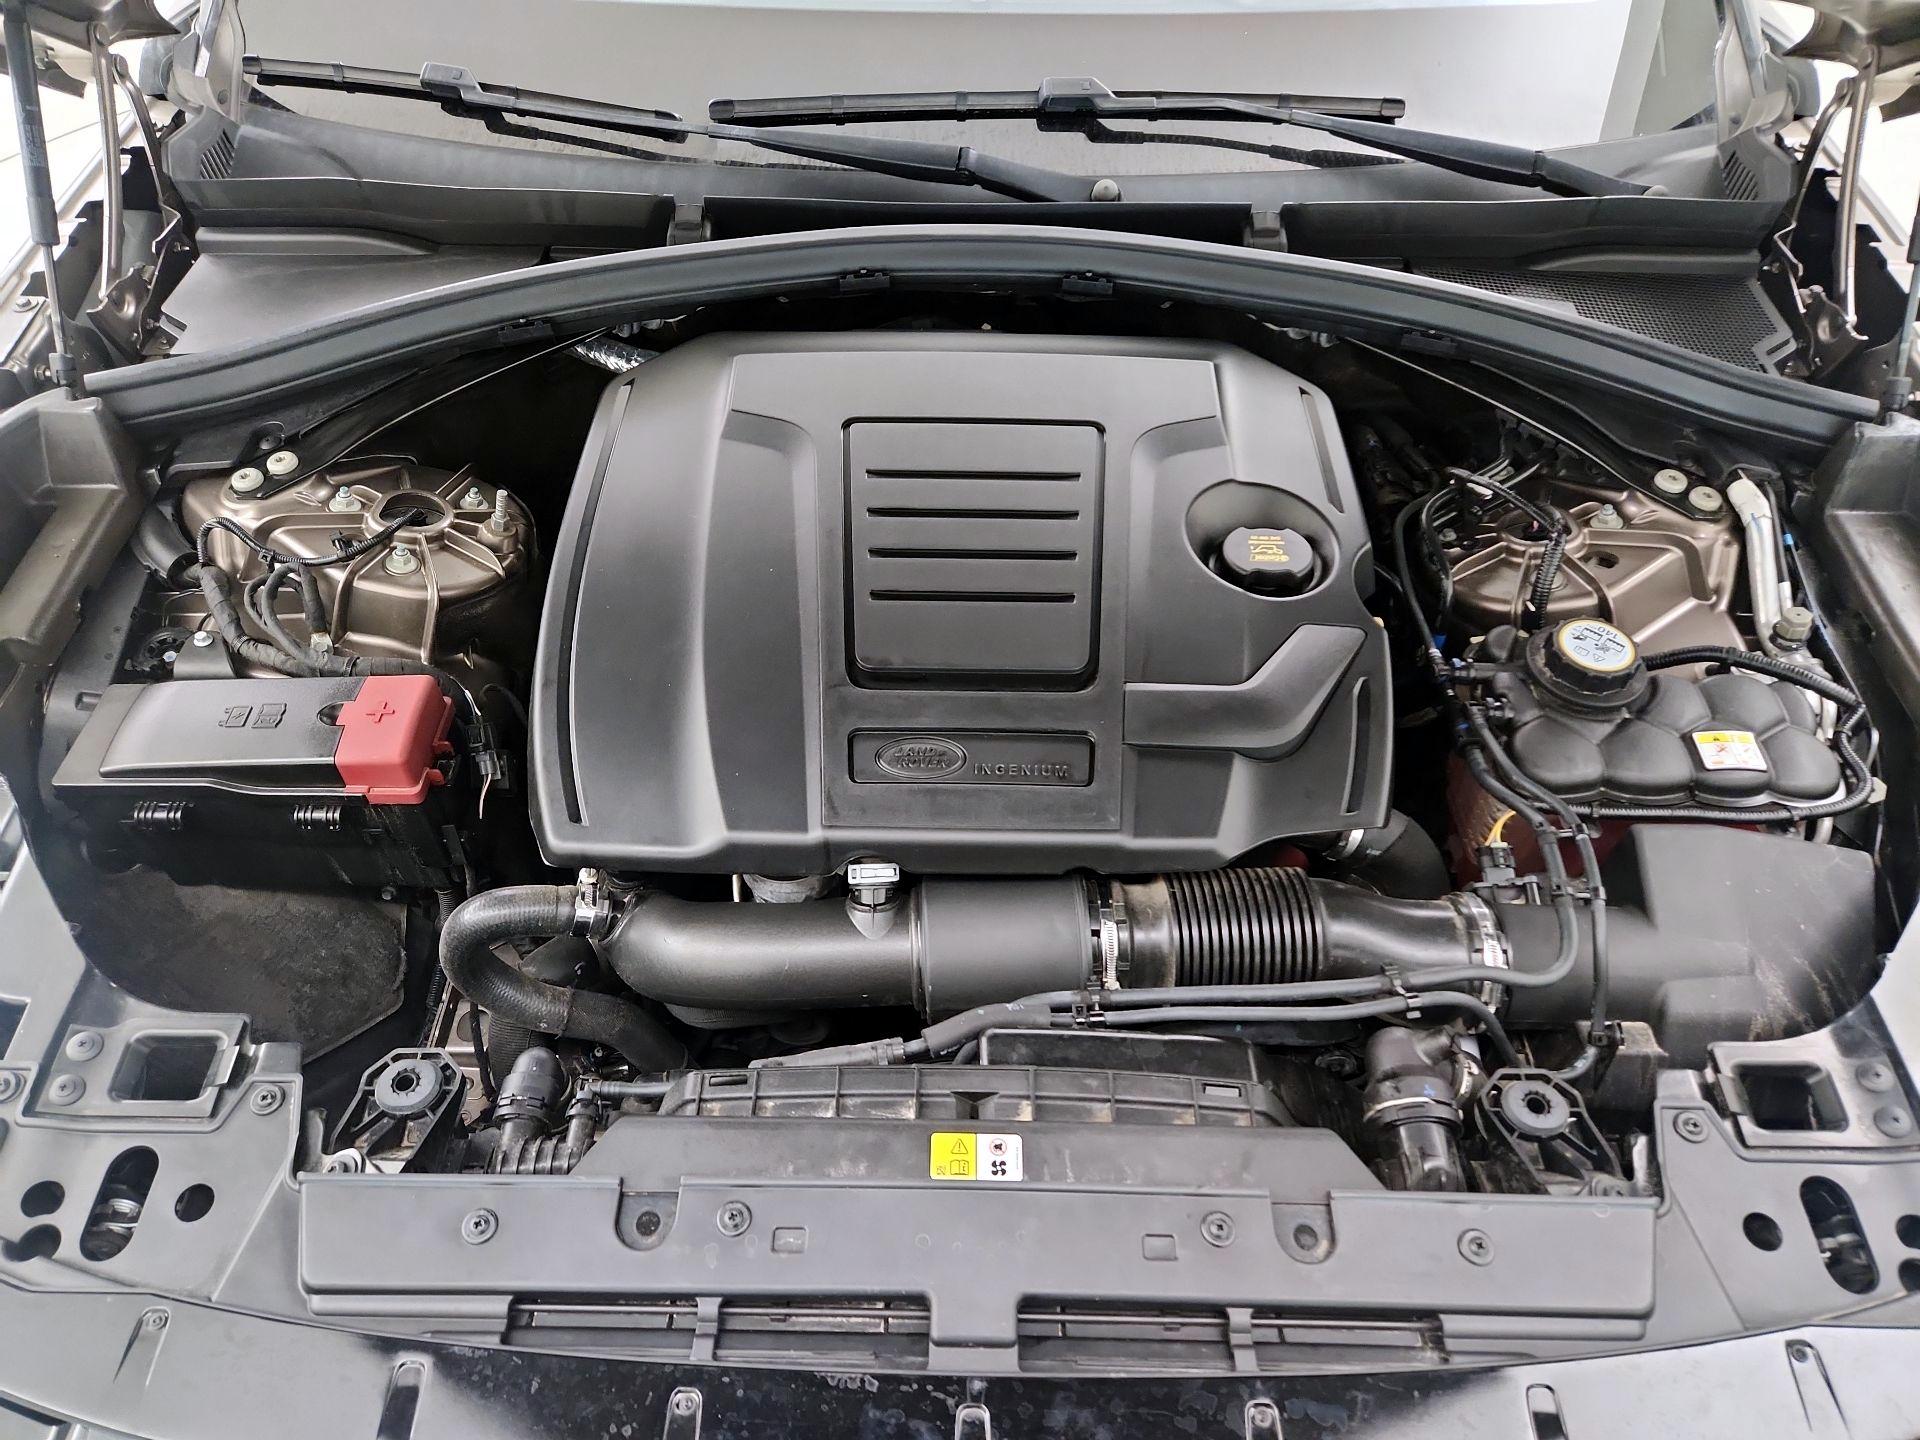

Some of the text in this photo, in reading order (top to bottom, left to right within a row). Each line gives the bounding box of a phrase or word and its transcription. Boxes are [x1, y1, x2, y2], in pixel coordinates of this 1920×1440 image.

[894, 746, 937, 757] LAND
[897, 757, 951, 768] ROVER
[973, 763, 1069, 778] INGENIUM
